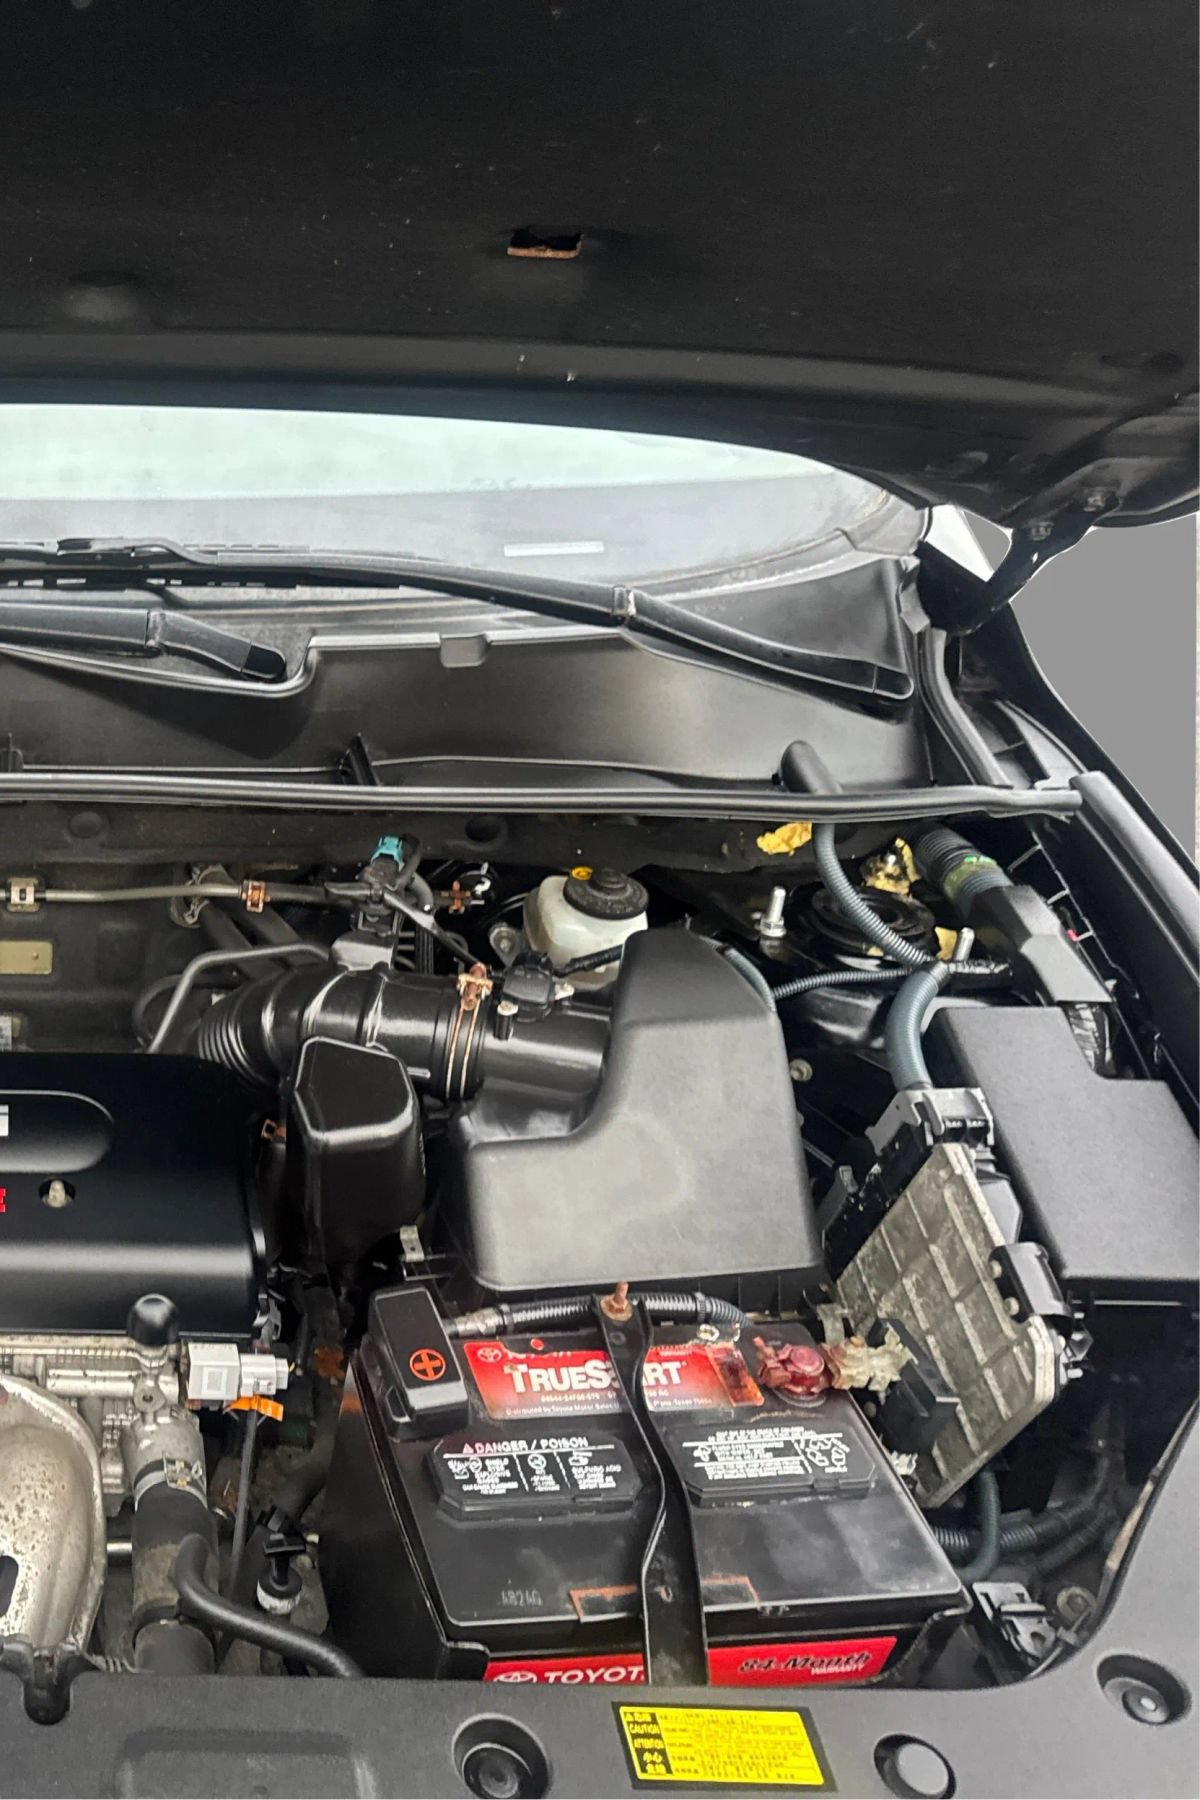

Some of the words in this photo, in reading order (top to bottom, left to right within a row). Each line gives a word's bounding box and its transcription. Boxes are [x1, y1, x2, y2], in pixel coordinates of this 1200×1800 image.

[475, 1440, 528, 1454] DANGER
[540, 1437, 589, 1449] POISON
[545, 1664, 645, 1684] TOYOT
[629, 1723, 660, 1734] CAUTION
